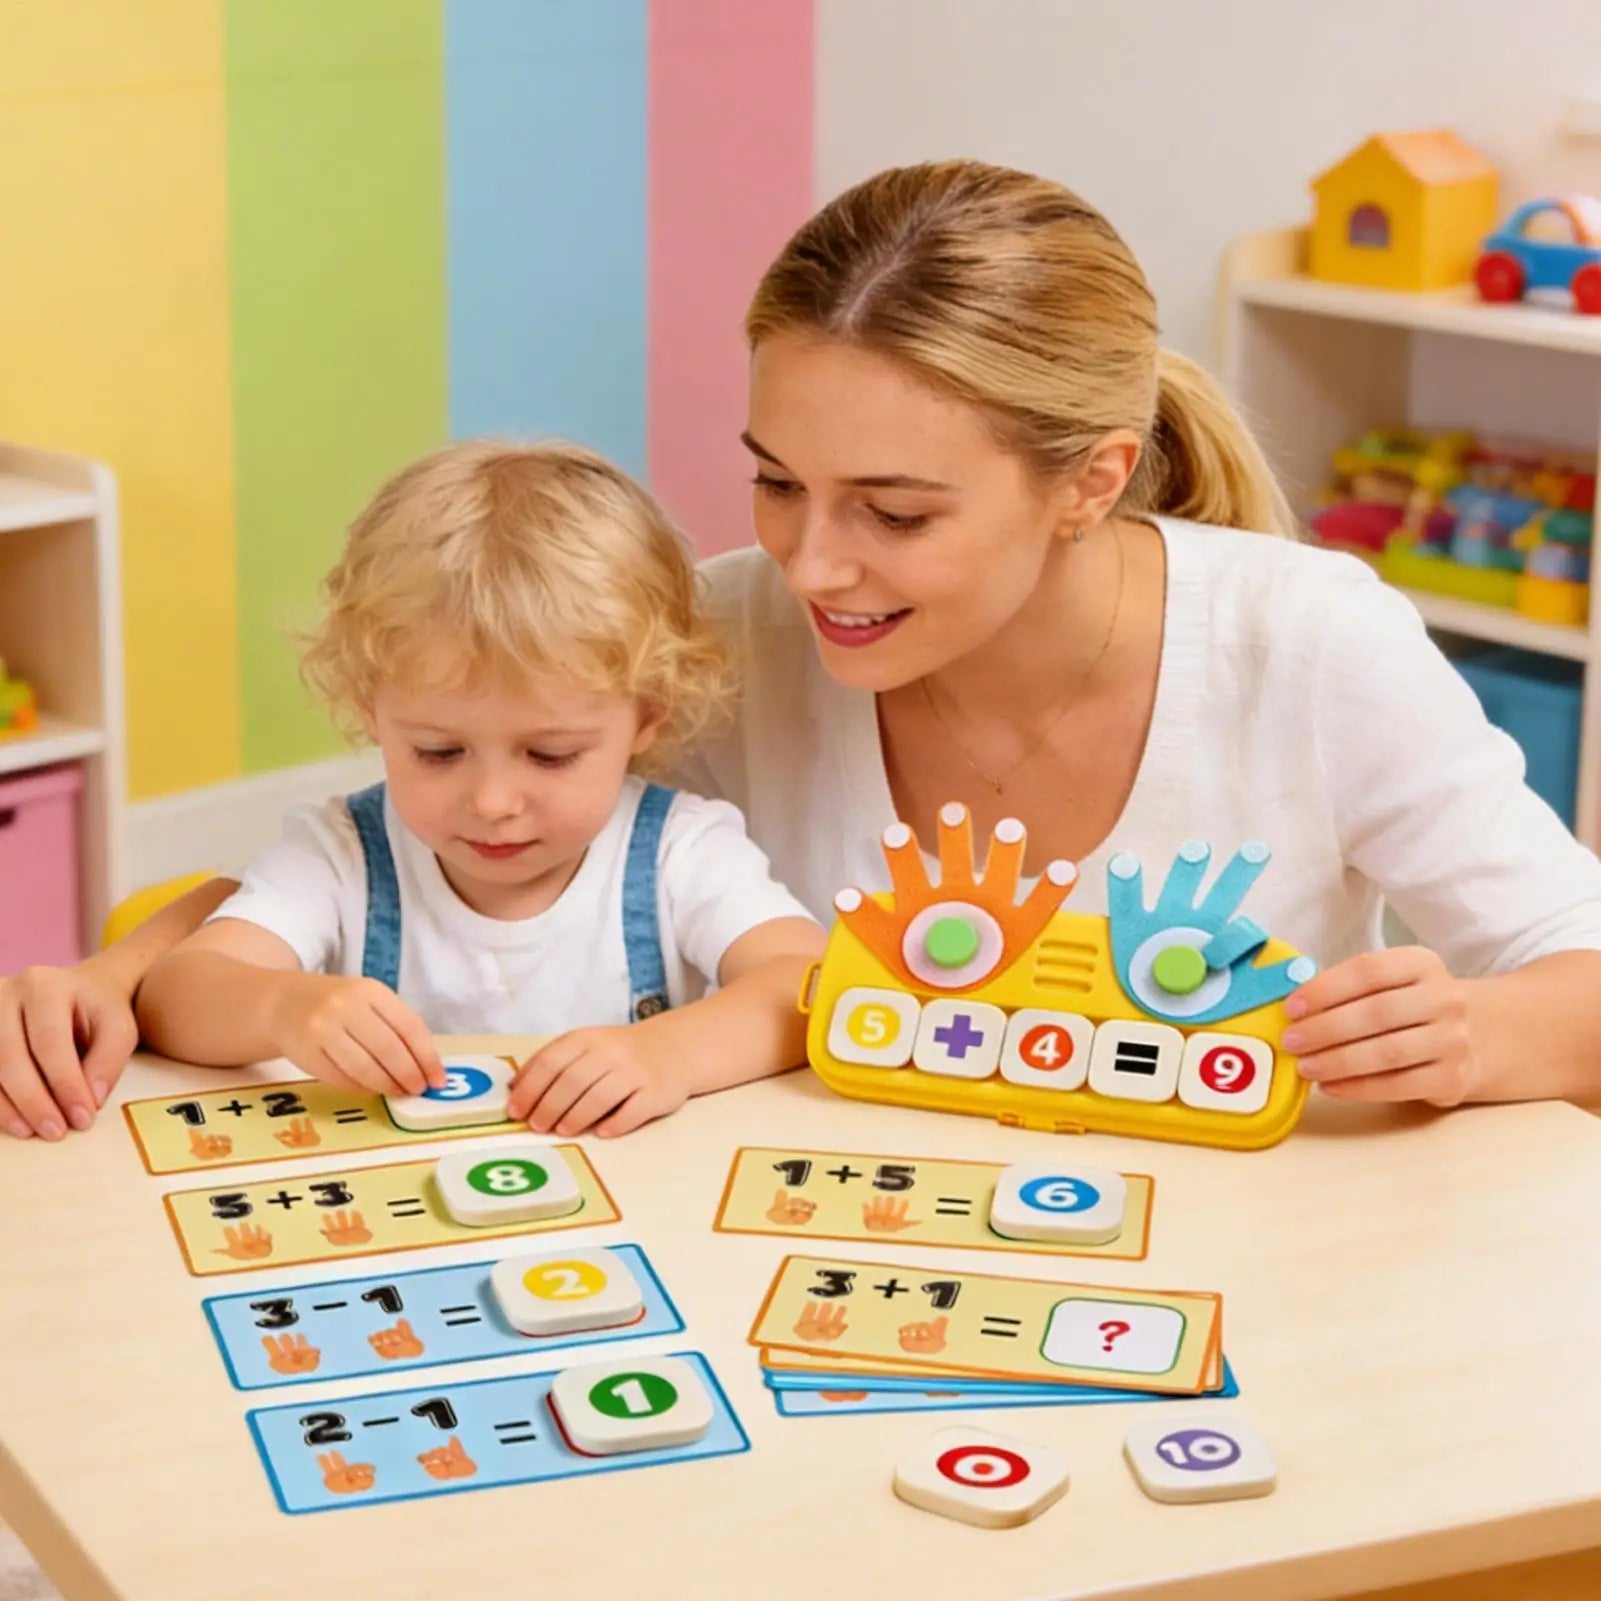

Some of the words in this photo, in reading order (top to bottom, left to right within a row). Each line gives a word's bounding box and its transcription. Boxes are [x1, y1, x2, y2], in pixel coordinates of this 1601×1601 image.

[860, 1012, 886, 1043] 5
[1031, 1032, 1061, 1067] 4
[1213, 1057, 1244, 1088] 9
[166, 1101, 206, 1126] 1
[262, 1092, 307, 1118] 2
[209, 1192, 253, 1219] 5
[309, 1181, 354, 1207] 3
[486, 1166, 530, 1192] 8
[773, 1159, 812, 1187] 1
[872, 1164, 916, 1192] 5
[1035, 1182, 1083, 1208] 6
[250, 1298, 299, 1329] 3
[361, 1284, 404, 1314] 1
[542, 1269, 590, 1297] 2
[807, 1269, 857, 1298] 3
[921, 1280, 962, 1309] 1
[1098, 1320, 1131, 1352] ?
[300, 1411, 352, 1447] 2
[410, 1397, 458, 1430] 1
[610, 1379, 653, 1414] 1
[954, 1453, 1012, 1482] 0
[1161, 1437, 1233, 1466] 10
